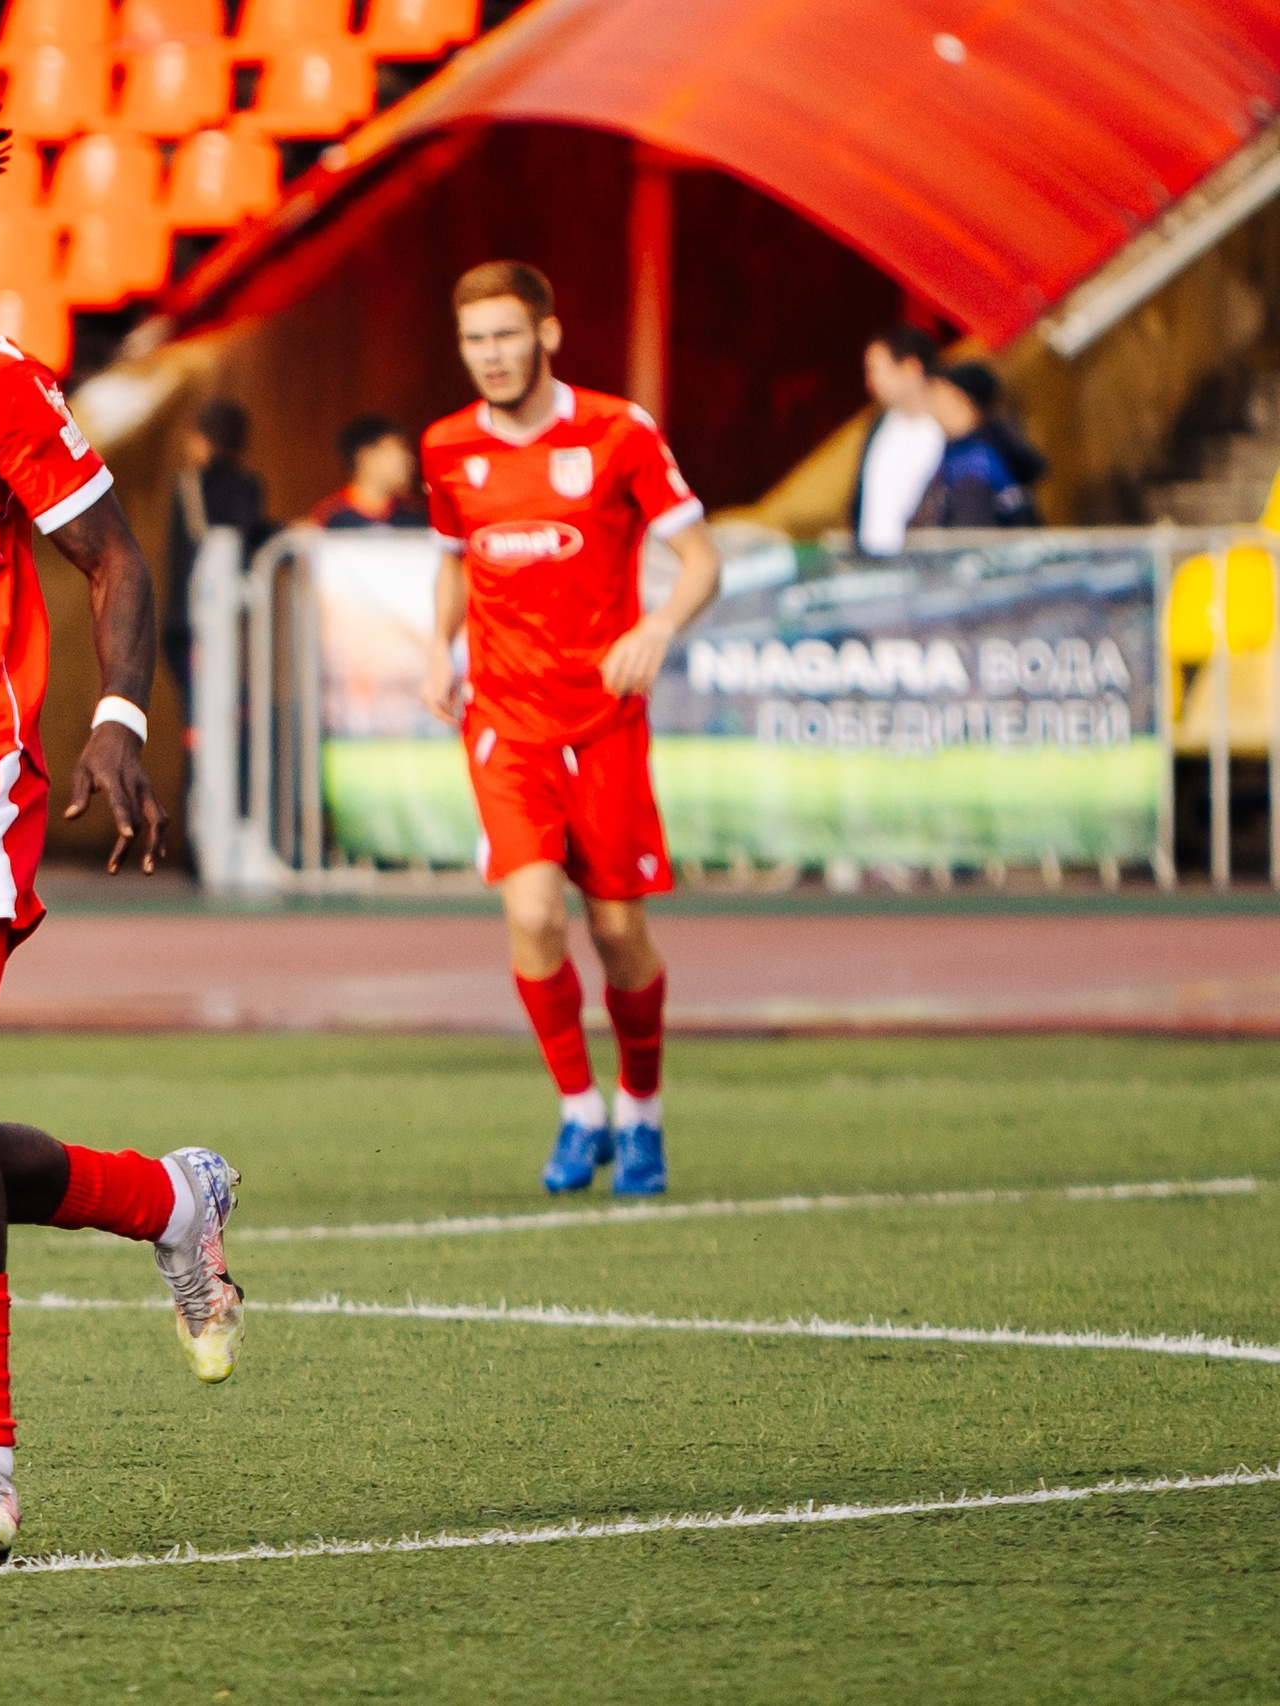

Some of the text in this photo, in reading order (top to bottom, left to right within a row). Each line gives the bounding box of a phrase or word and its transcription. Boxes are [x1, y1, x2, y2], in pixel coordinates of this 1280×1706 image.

[486, 527, 560, 558] amet
[689, 637, 1131, 697] NIAGARA ВОДА
[756, 695, 1132, 753] ПОБЕДИТЕЛЕЙ
